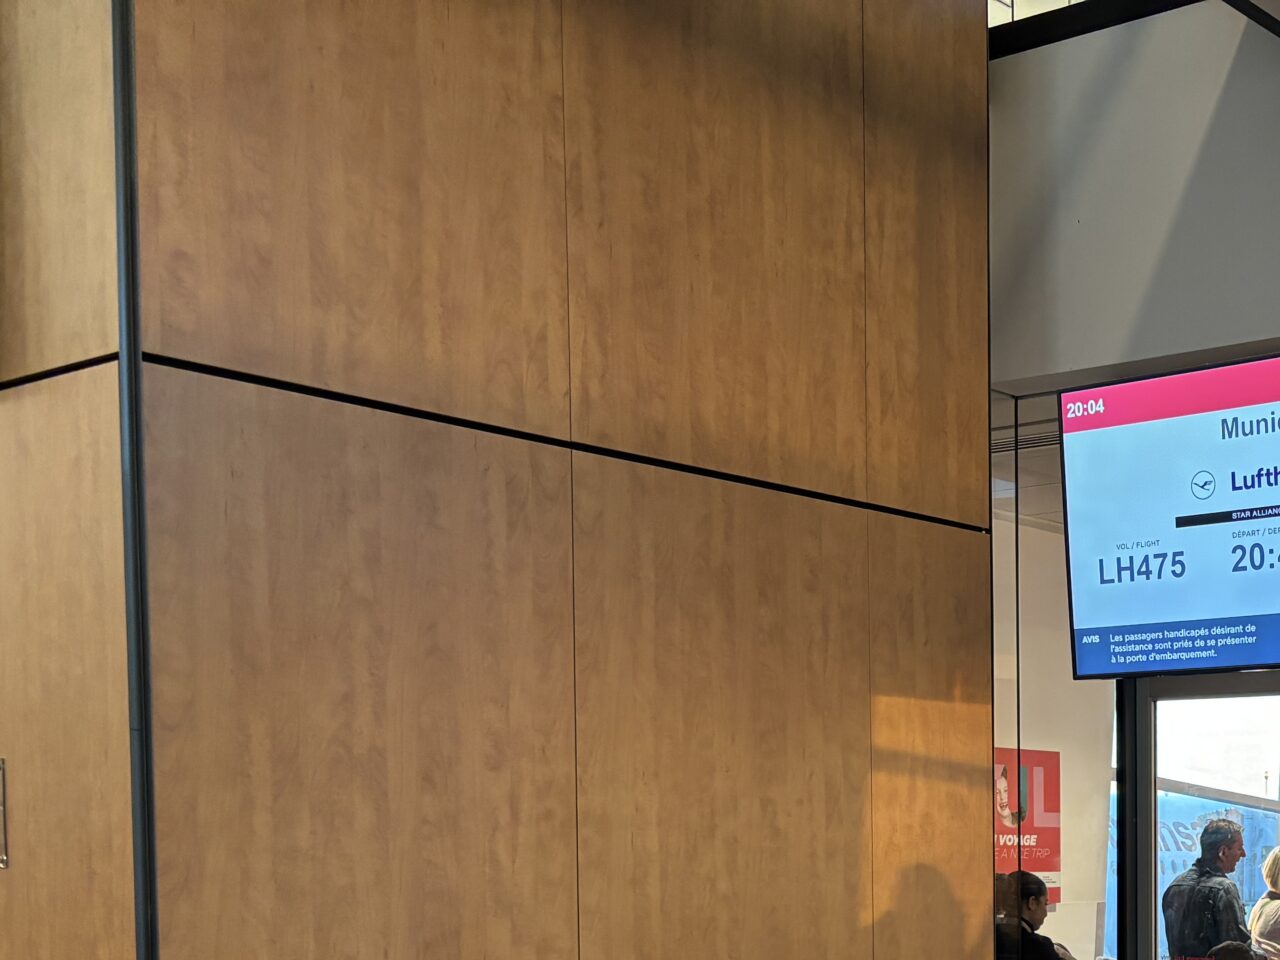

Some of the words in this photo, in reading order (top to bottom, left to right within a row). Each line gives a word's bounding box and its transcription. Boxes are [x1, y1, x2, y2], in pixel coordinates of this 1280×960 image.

[1066, 398, 1104, 418] 20:04
[1232, 510, 1250, 519] STAR
[1232, 528, 1260, 538] DÉPART
[1116, 542, 1130, 550] VOL
[1136, 540, 1160, 548] FLIGHT
[1099, 551, 1186, 584] LH475
[1082, 635, 1100, 644] AVIS
[1110, 634, 1123, 642] Les
[1124, 631, 1162, 642] passagers
[1164, 626, 1209, 638] handicapés
[1211, 624, 1243, 635] désirant
[1245, 624, 1256, 632] de
[1110, 642, 1152, 652] l'assistance
[1154, 640, 1172, 650] sont
[1174, 638, 1192, 650] priés
[1194, 638, 1205, 646] de
[1206, 638, 1216, 646] se
[1218, 636, 1256, 646] présenter
[1112, 654, 1116, 663] à
[1117, 654, 1124, 662] la
[1126, 653, 1147, 664] porte
[1149, 650, 1218, 662] d'embarquement.
